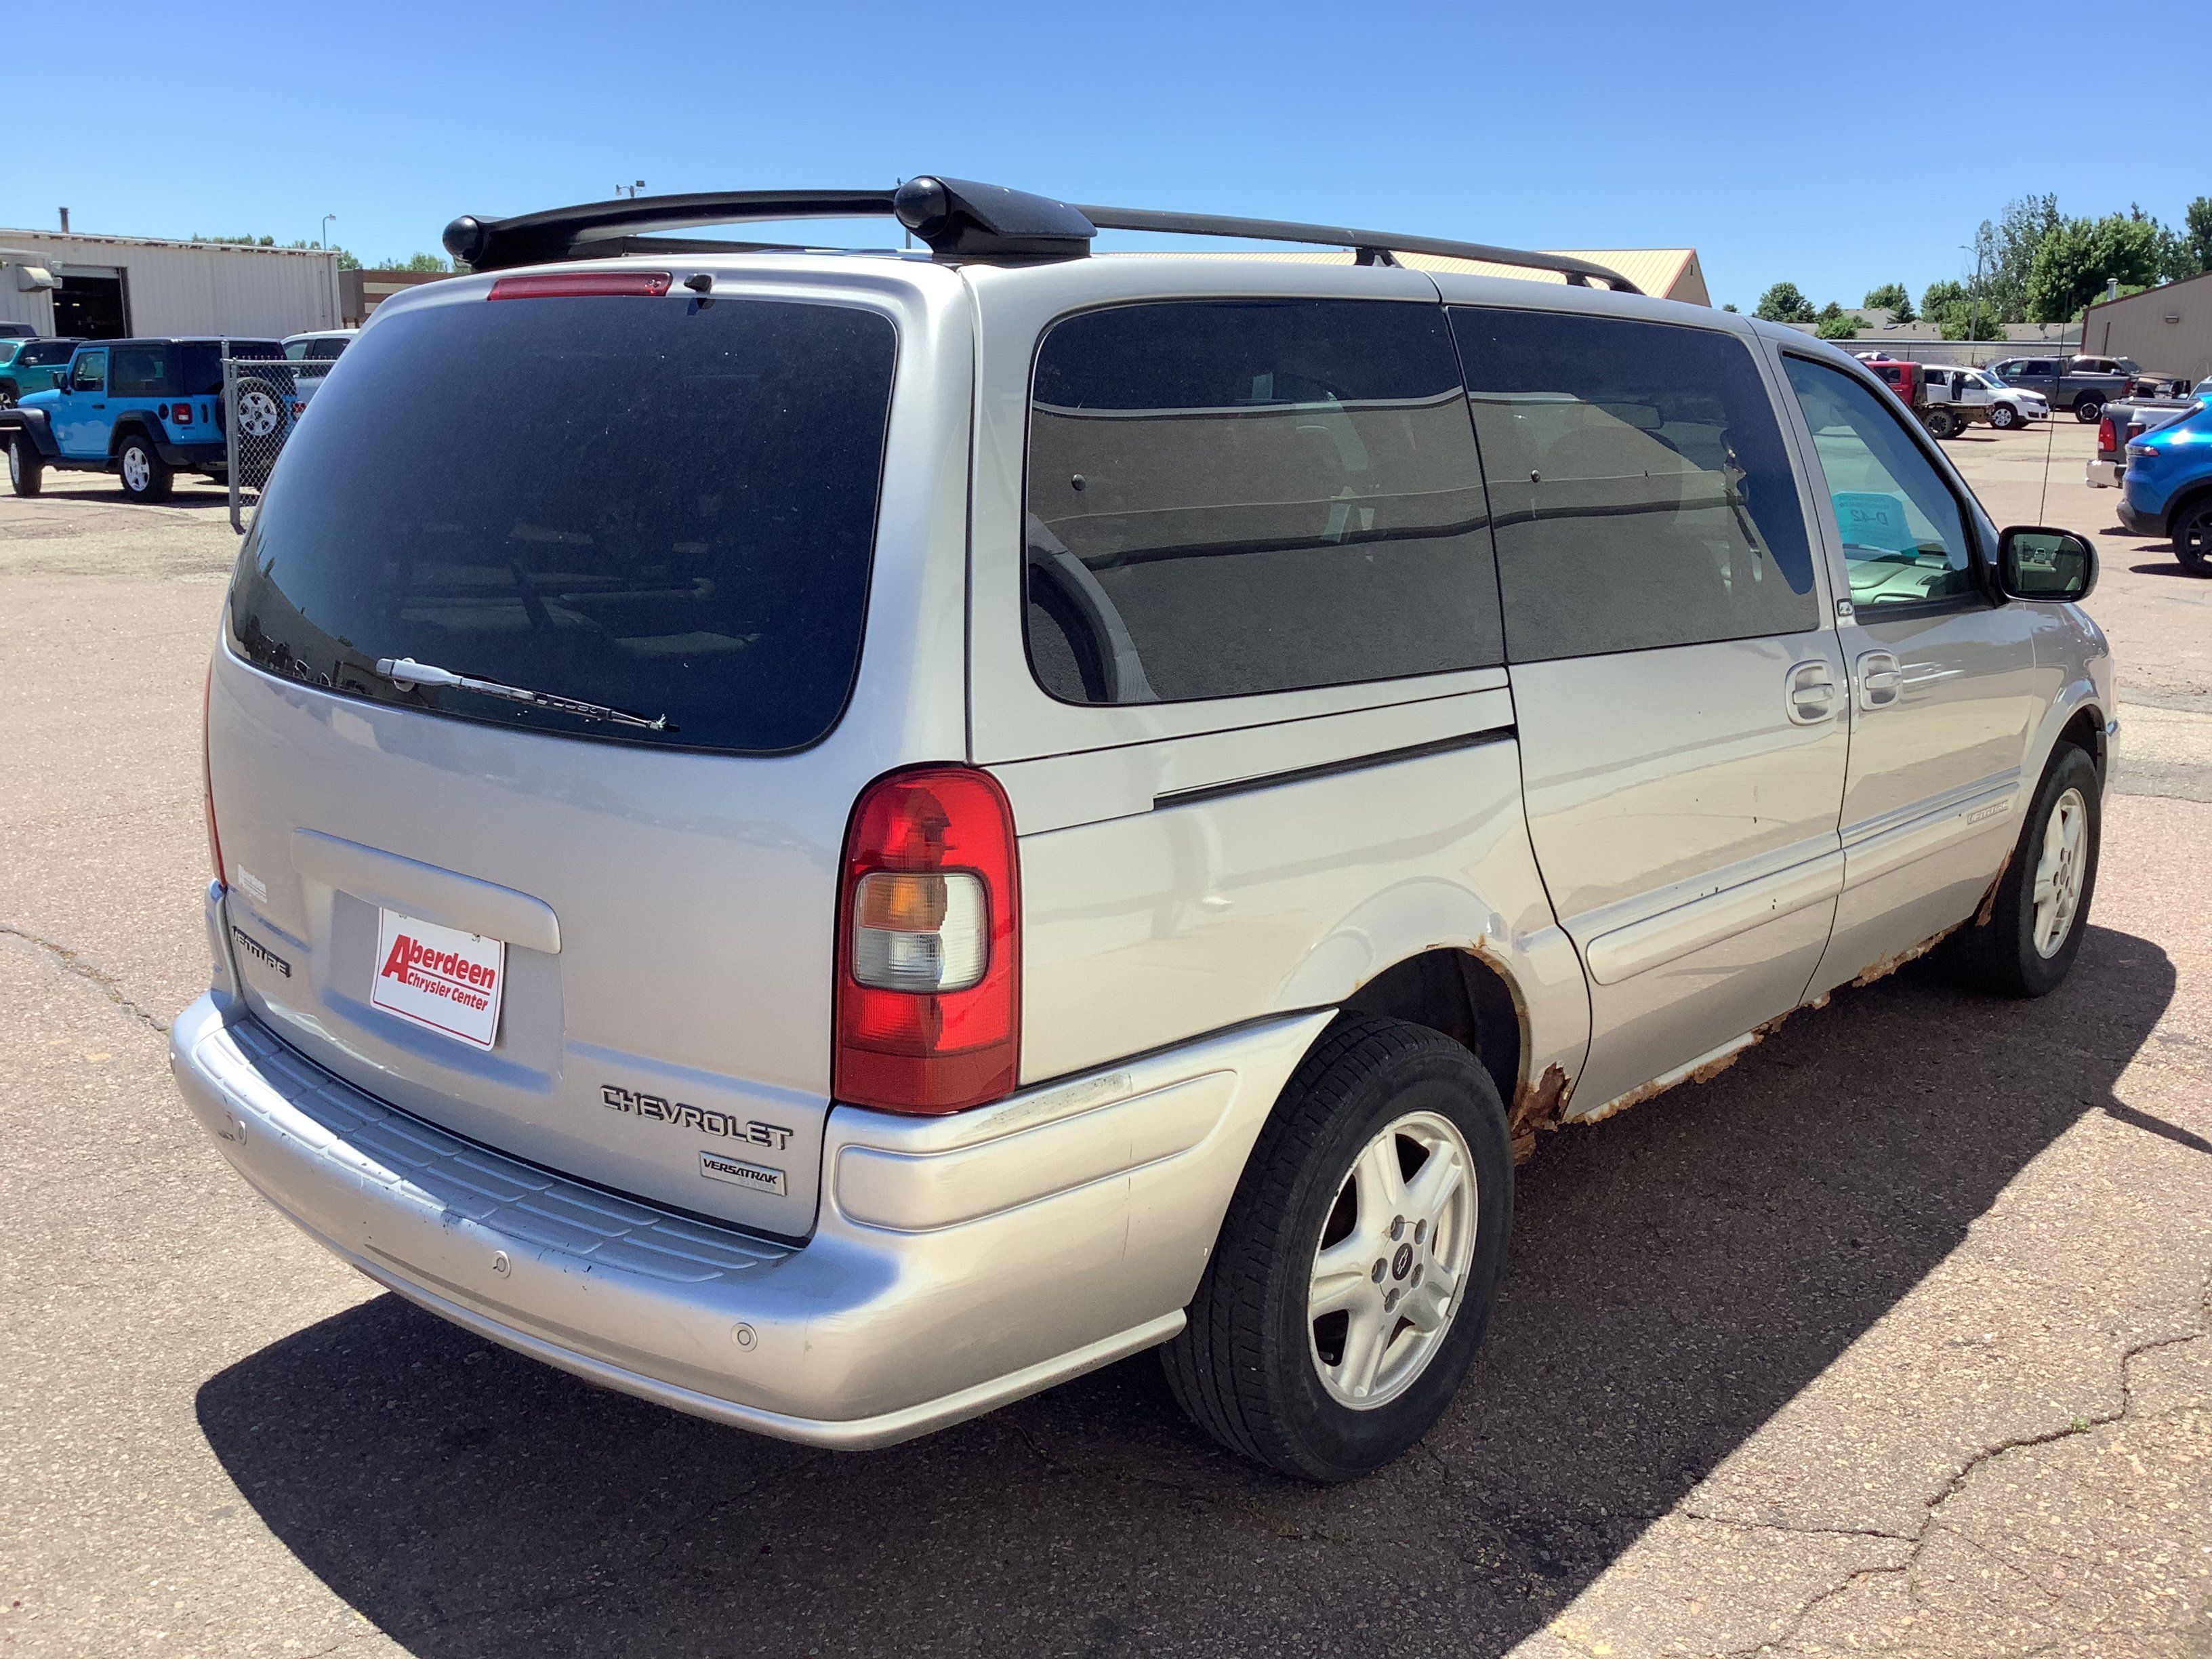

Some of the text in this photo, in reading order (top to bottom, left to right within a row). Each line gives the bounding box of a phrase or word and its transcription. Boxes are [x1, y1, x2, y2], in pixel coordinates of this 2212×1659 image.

[1967, 800, 2009, 825] VENTURE
[381, 933, 496, 989] Aberdeen
[407, 972, 489, 1012] Chrysler Center
[600, 1084, 794, 1150] CHEVROLET
[703, 1158, 779, 1185] VERSATRAK
